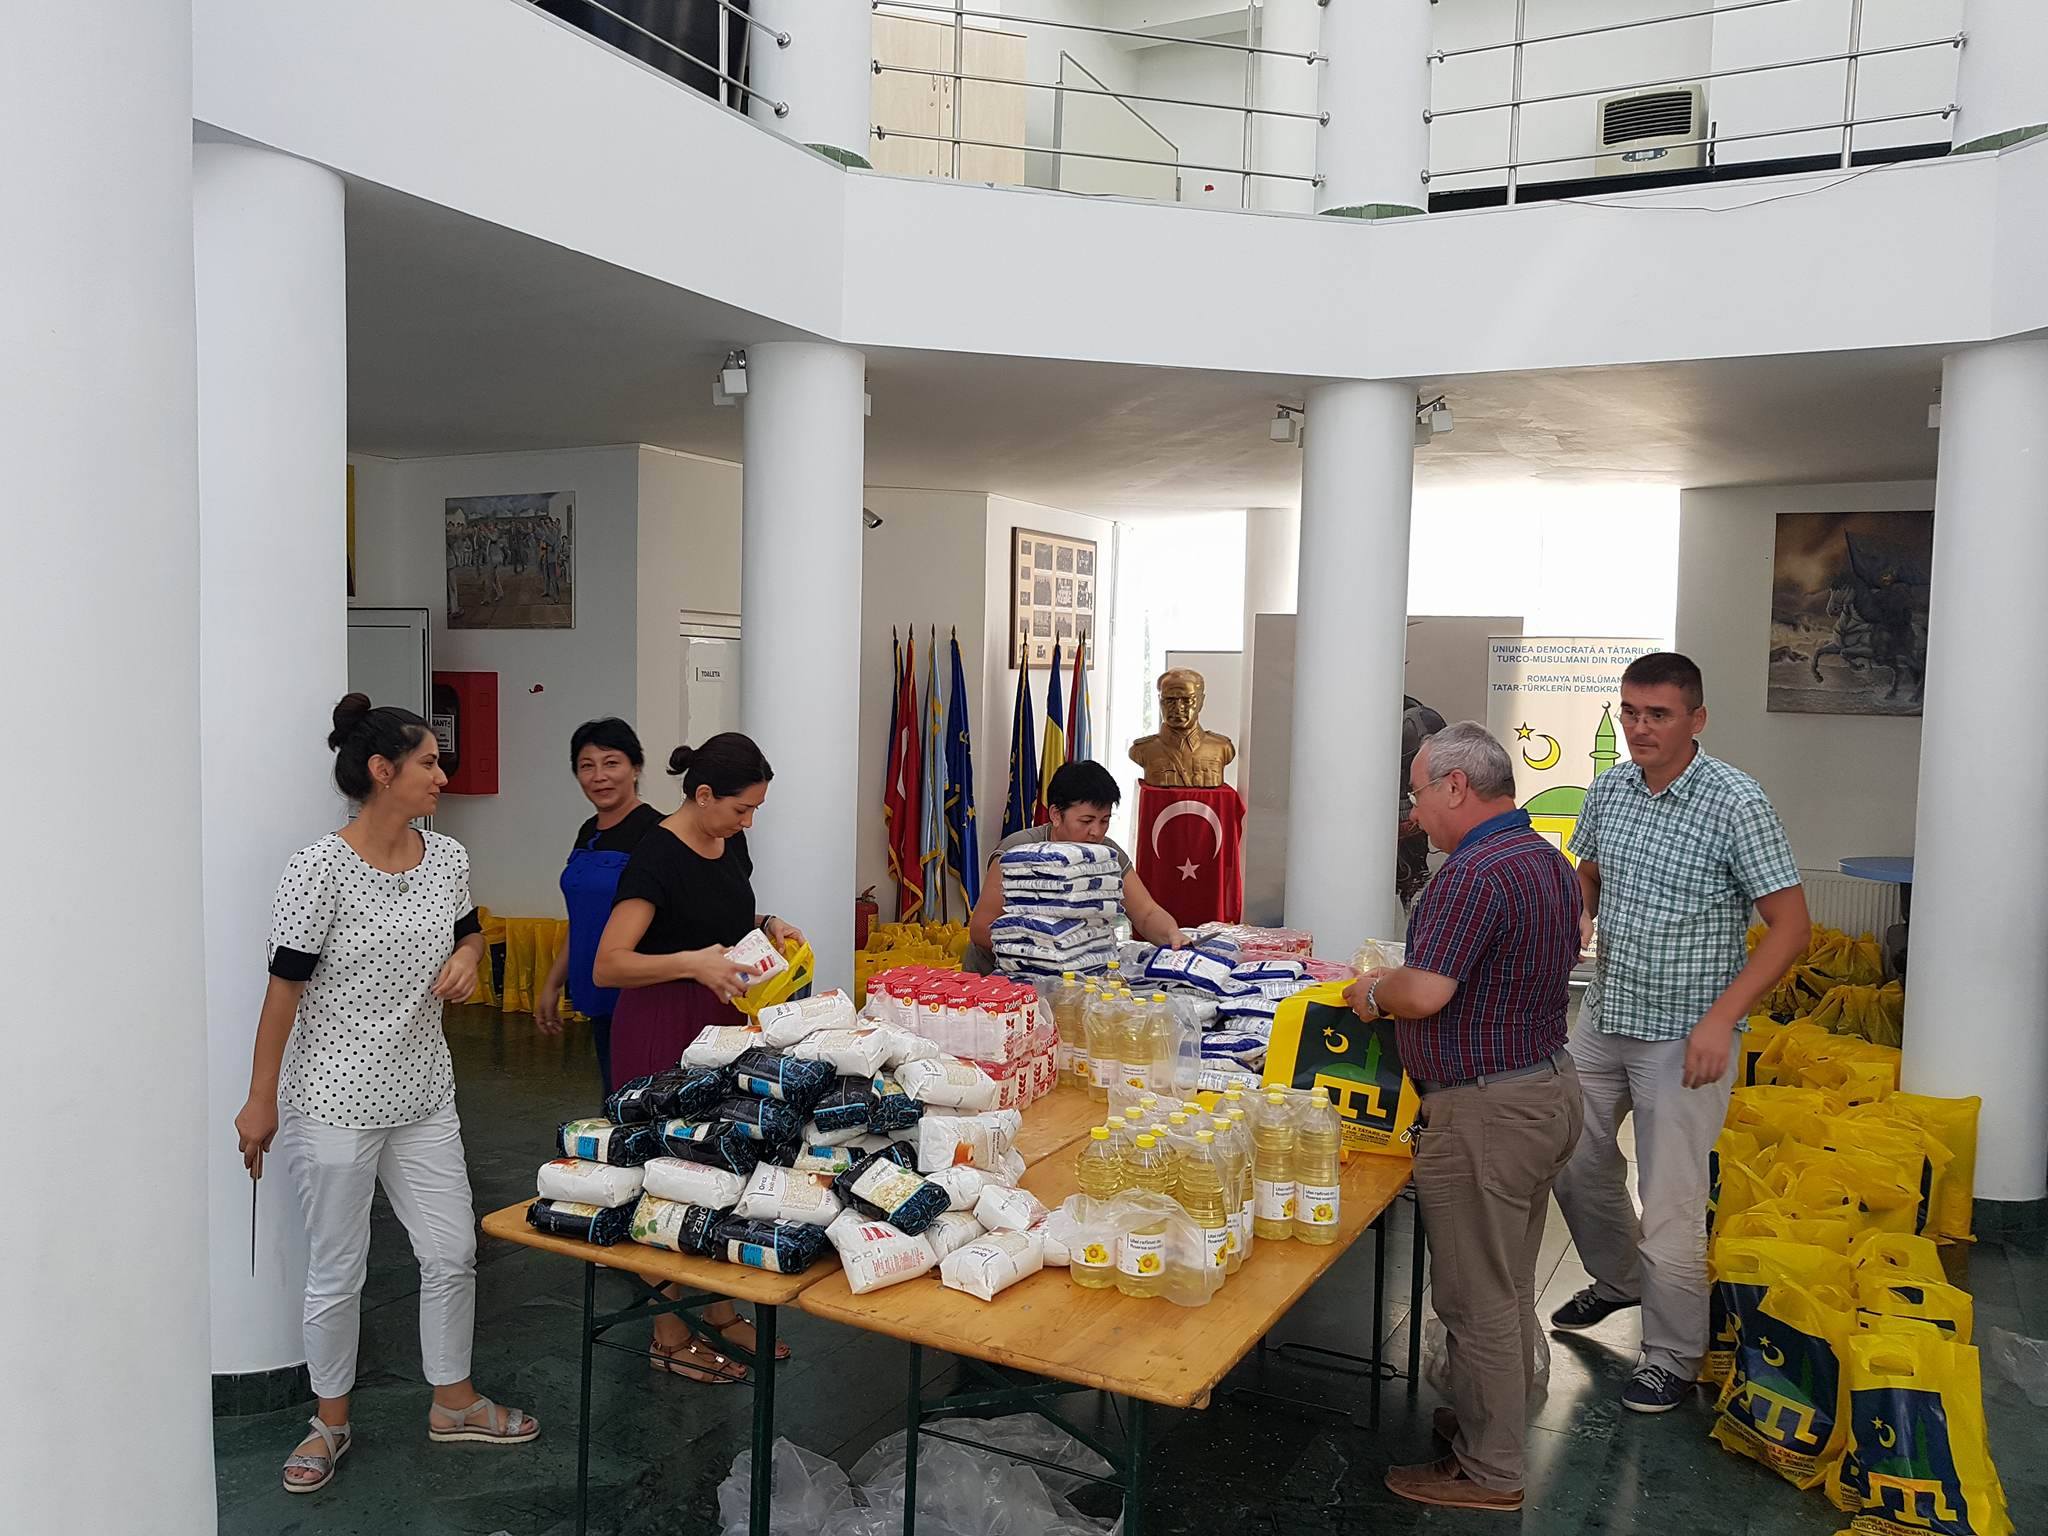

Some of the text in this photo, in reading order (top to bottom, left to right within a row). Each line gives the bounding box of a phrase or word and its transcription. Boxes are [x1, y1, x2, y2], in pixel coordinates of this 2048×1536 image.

[1492, 645, 1534, 653] UNIUNEA
[1497, 655, 1589, 664] TURCO-MUSULMANI
[1592, 656, 1608, 664] DIN
[1527, 675, 1570, 683] ROMANYA
[692, 1206, 708, 1233] OREZ
